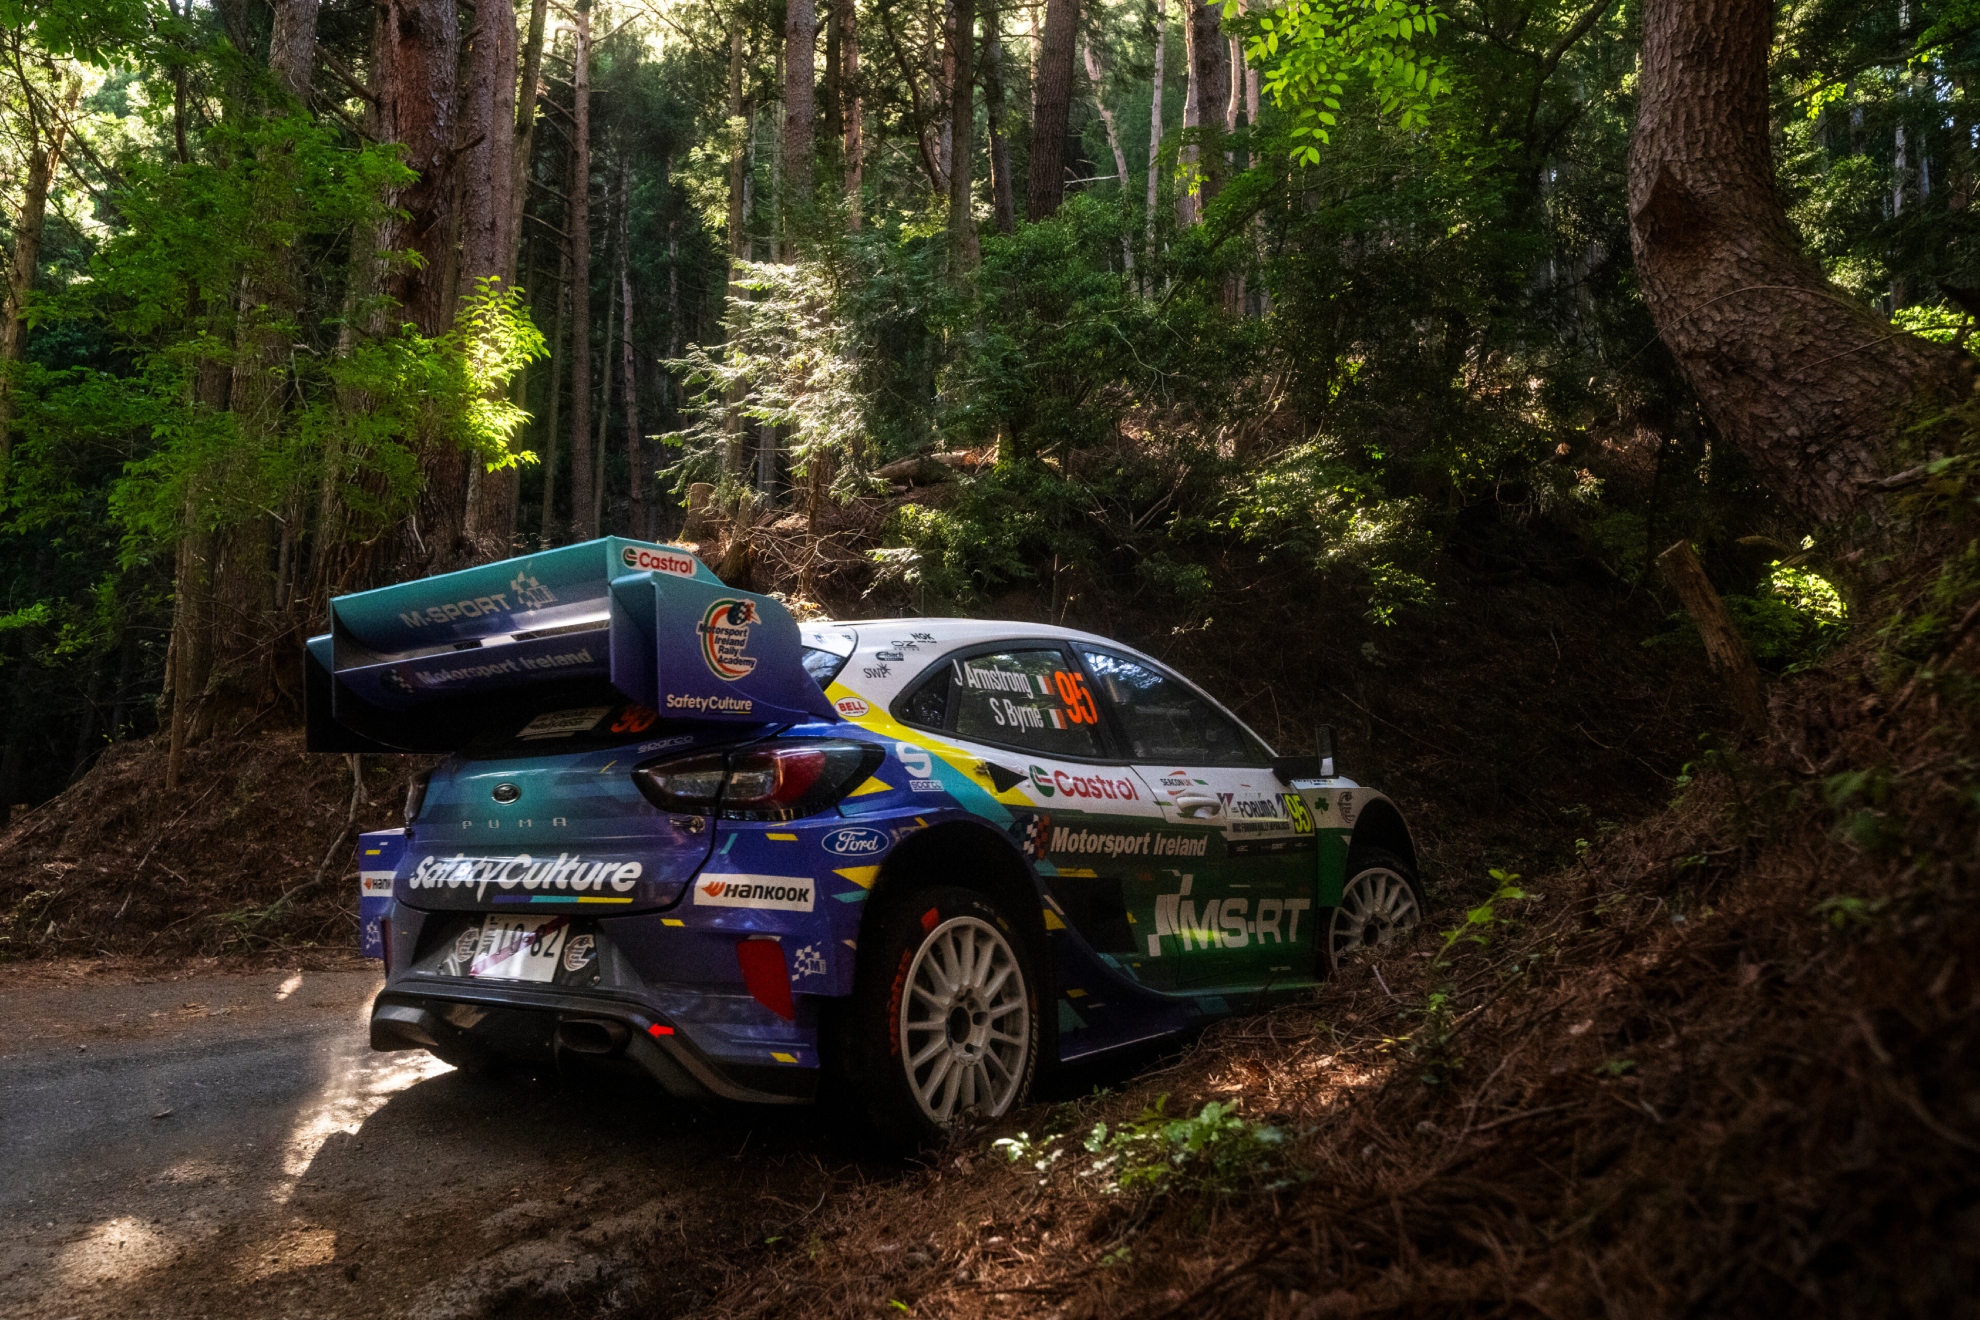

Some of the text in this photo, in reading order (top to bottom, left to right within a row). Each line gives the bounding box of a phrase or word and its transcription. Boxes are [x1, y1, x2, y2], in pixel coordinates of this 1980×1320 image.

[639, 552, 693, 574] Castrol
[698, 623, 748, 638] Motorsport
[714, 635, 746, 647] Ireland
[910, 633, 934, 641] NGK
[717, 655, 756, 668] Academy
[718, 645, 740, 657] Rally
[415, 648, 595, 685] Motorsport Ireland
[952, 659, 1034, 699] J Armstrong
[666, 694, 753, 713] SafetyCulture
[838, 701, 867, 712] BELL
[1054, 671, 1098, 725] 95
[989, 697, 1044, 733] S Byrne
[637, 735, 694, 754] sparco
[1053, 769, 1139, 801] Castrol
[1283, 793, 1312, 833] 95
[835, 830, 879, 853] Ford
[1050, 826, 1209, 859] Motorsport Ireland
[409, 852, 643, 903] SafetyCulture
[1179, 897, 1311, 951] MS-RT
